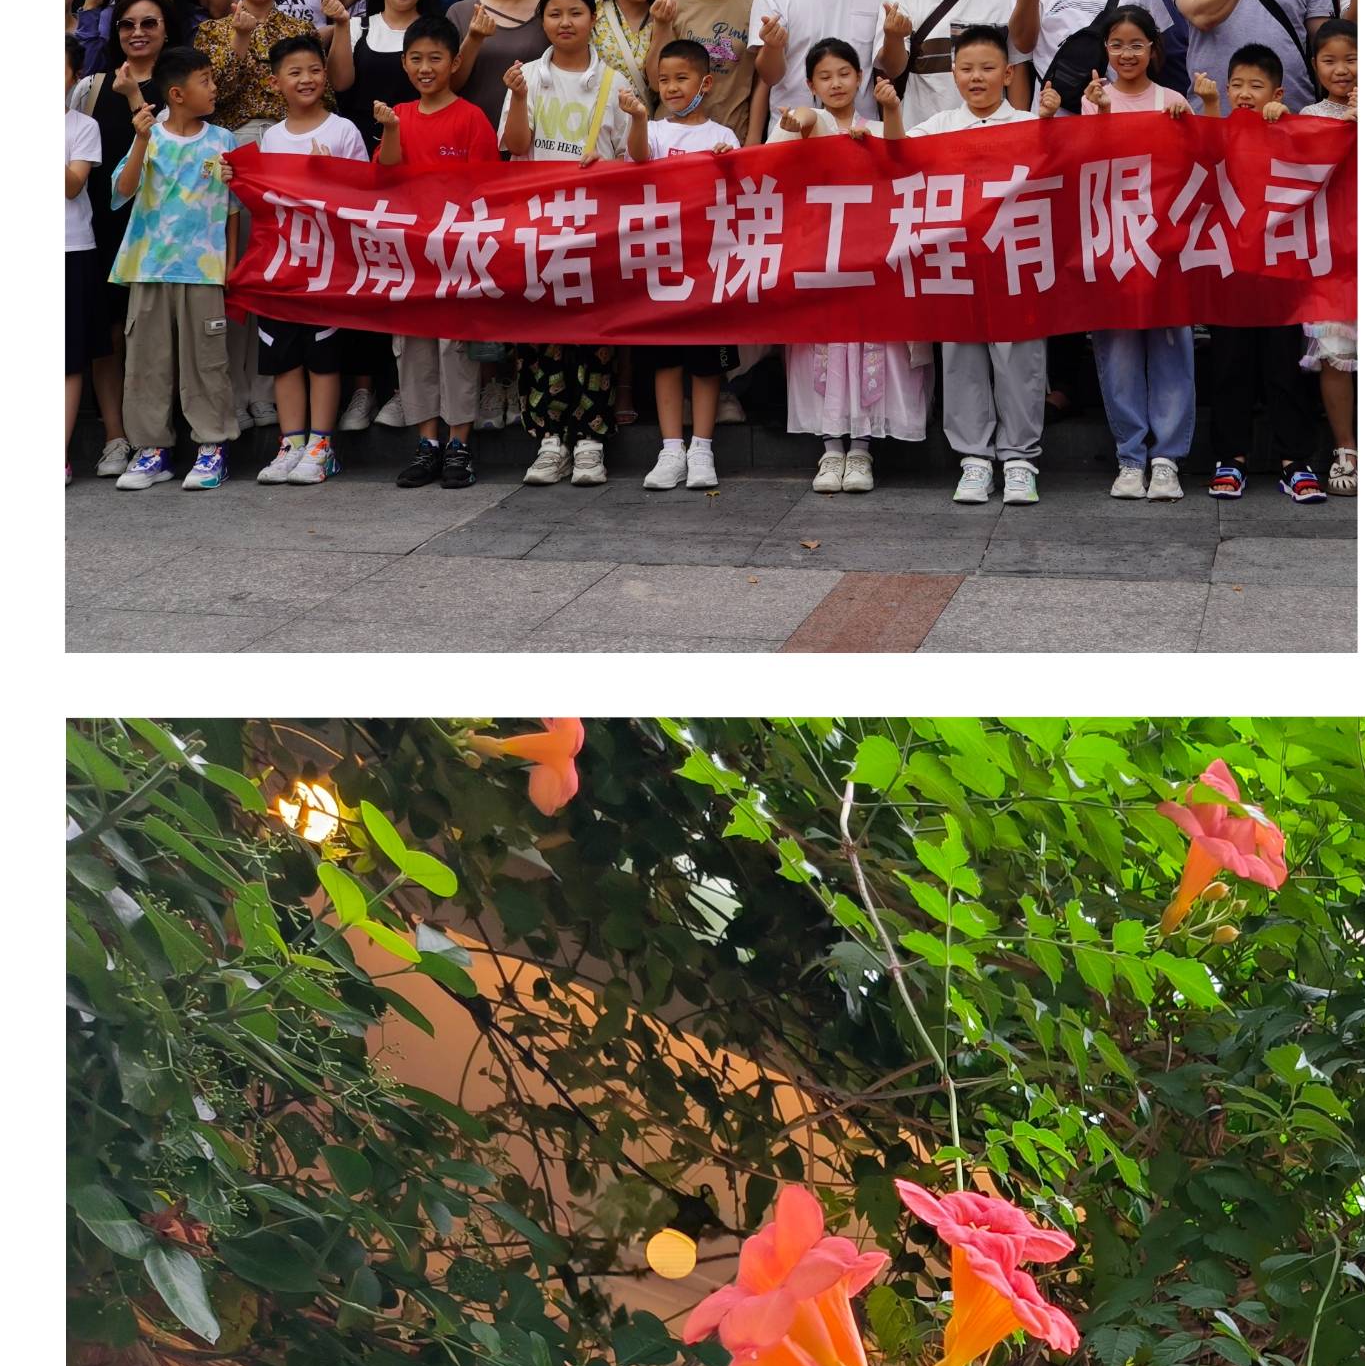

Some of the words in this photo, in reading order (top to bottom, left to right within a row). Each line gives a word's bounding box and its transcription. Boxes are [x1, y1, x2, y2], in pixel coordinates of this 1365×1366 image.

[263, 153, 1336, 307] 河南依诺电梯工程有限公司
